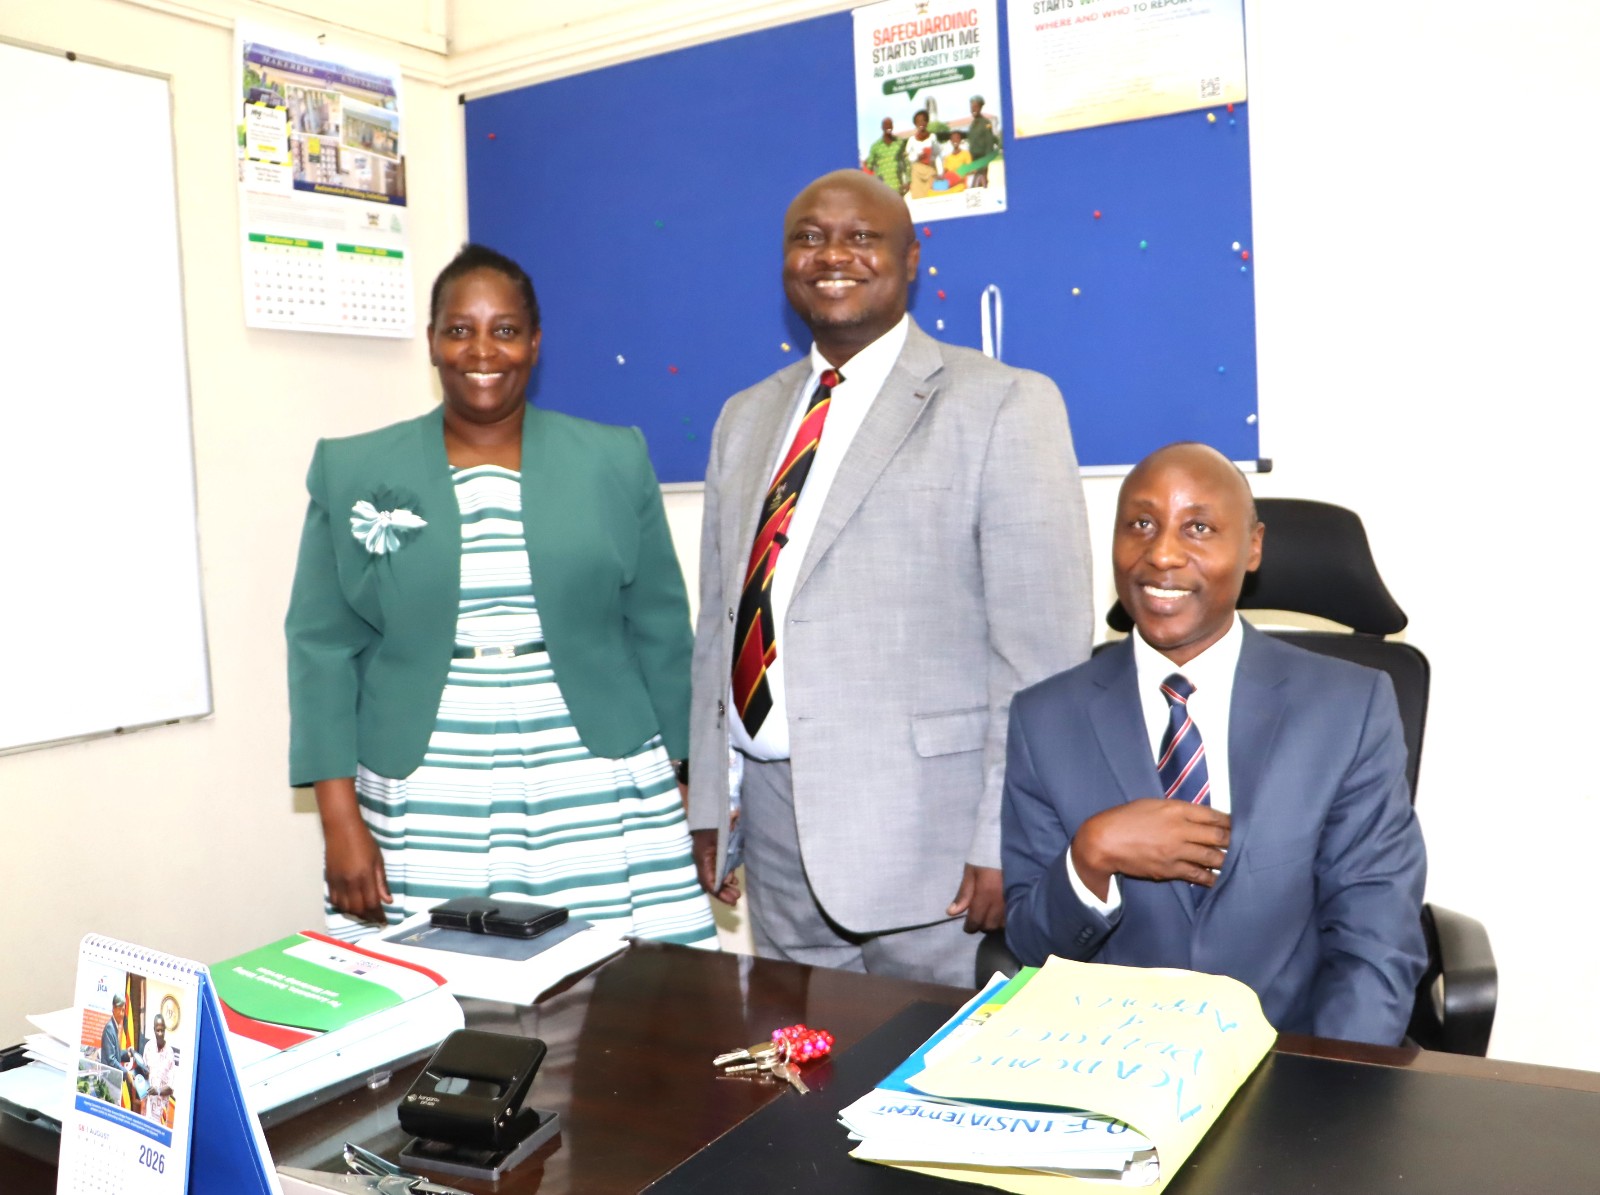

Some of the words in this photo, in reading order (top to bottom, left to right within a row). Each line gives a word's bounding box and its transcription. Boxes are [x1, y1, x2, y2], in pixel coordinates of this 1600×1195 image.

[873, 9, 978, 47] SAFEGUARDING
[1035, 17, 1072, 31] WHERE
[1075, 12, 1098, 24] AND
[1102, 6, 1130, 18] WHO
[1133, 2, 1147, 12] TO
[872, 40, 917, 63] STARTS
[921, 34, 955, 53] WITH
[959, 28, 980, 45] ME
[873, 66, 885, 78] AS
[887, 63, 893, 75] A
[896, 52, 949, 73] UNIVERSITY
[953, 46, 980, 61] STAFF
[89, 1128, 110, 1141] AUGUST
[139, 1144, 166, 1174] 2026
